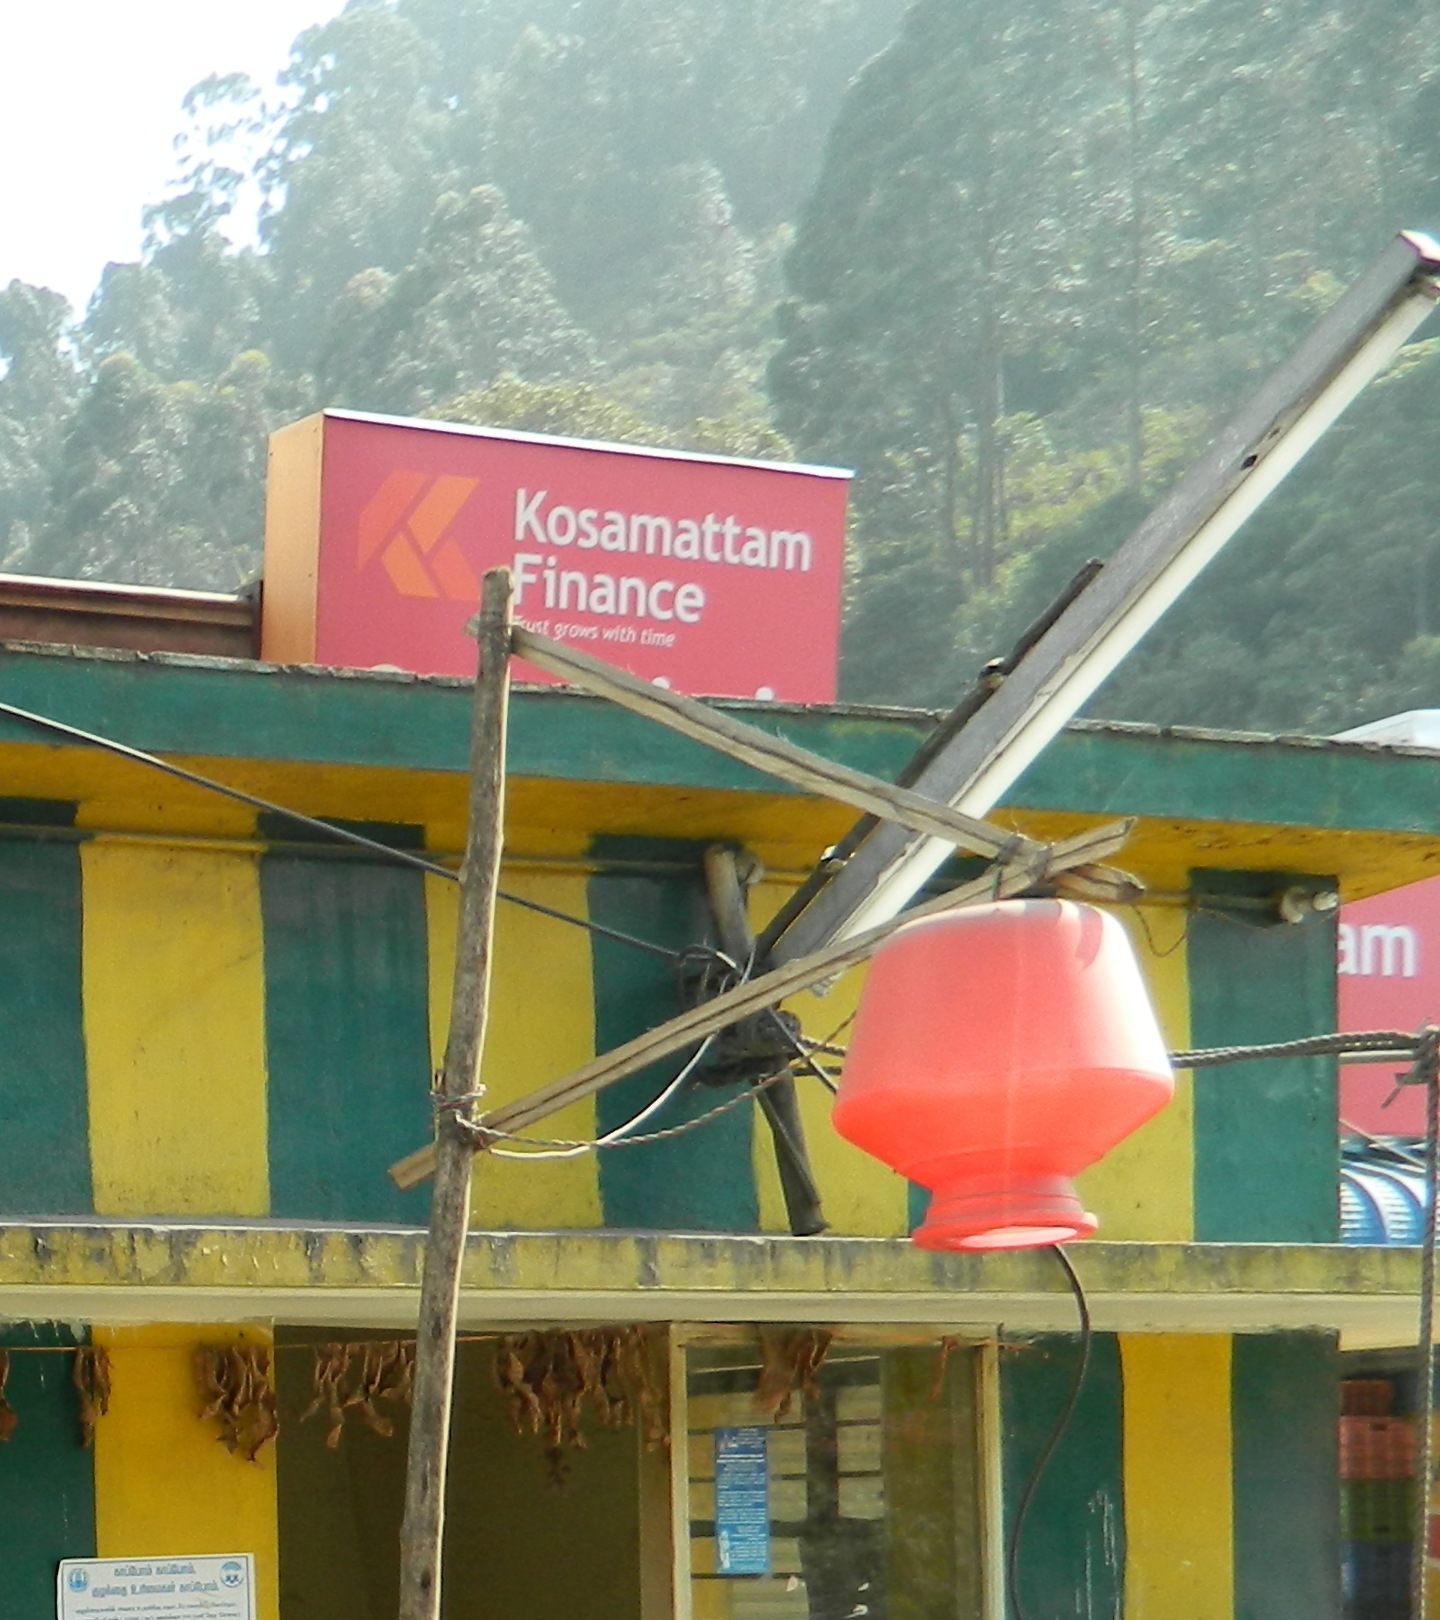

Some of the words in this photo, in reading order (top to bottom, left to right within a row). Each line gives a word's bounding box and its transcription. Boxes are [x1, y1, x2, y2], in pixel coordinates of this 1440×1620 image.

[513, 487, 812, 573] Kosamattam
[512, 552, 706, 625] Finance
[553, 621, 599, 642] grows
[602, 625, 637, 643] with
[640, 627, 677, 648] time
